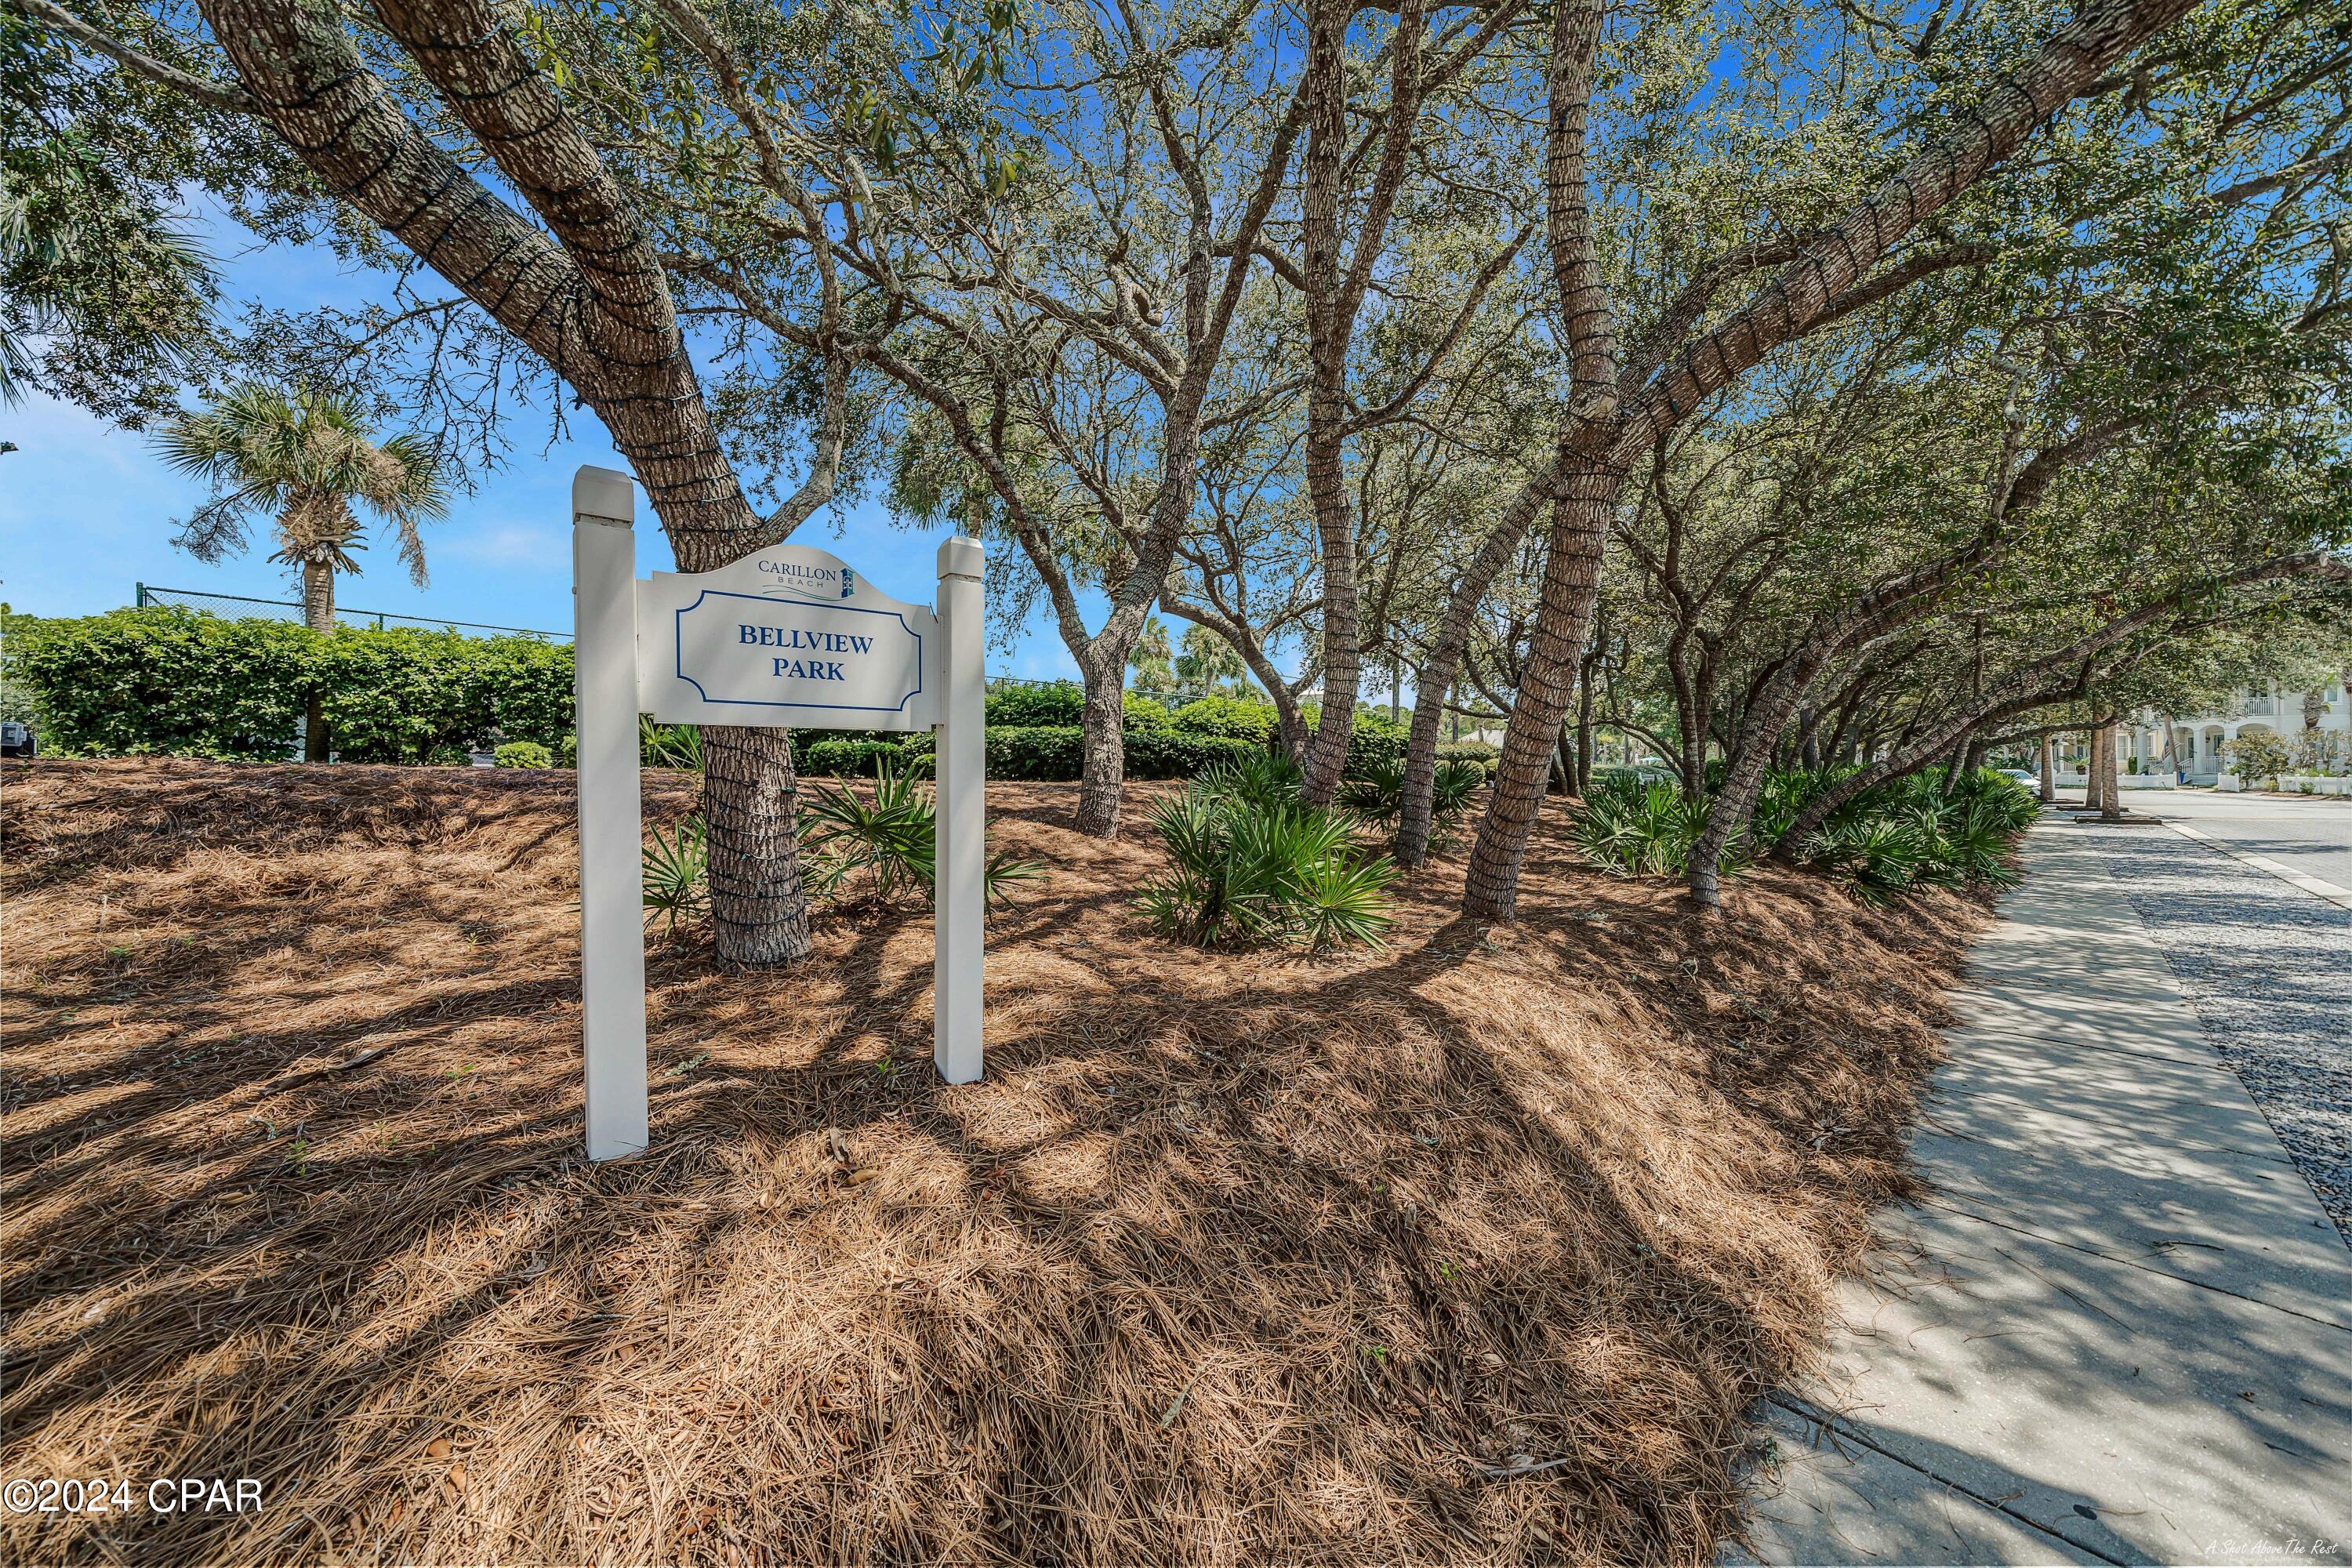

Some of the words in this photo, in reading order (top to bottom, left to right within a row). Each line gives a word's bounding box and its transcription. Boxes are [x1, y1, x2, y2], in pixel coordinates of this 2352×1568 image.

[758, 560, 837, 582] CARILLON
[779, 576, 824, 588] BEACH
[739, 624, 873, 654] BELLVIEW
[772, 657, 845, 681] PARK
